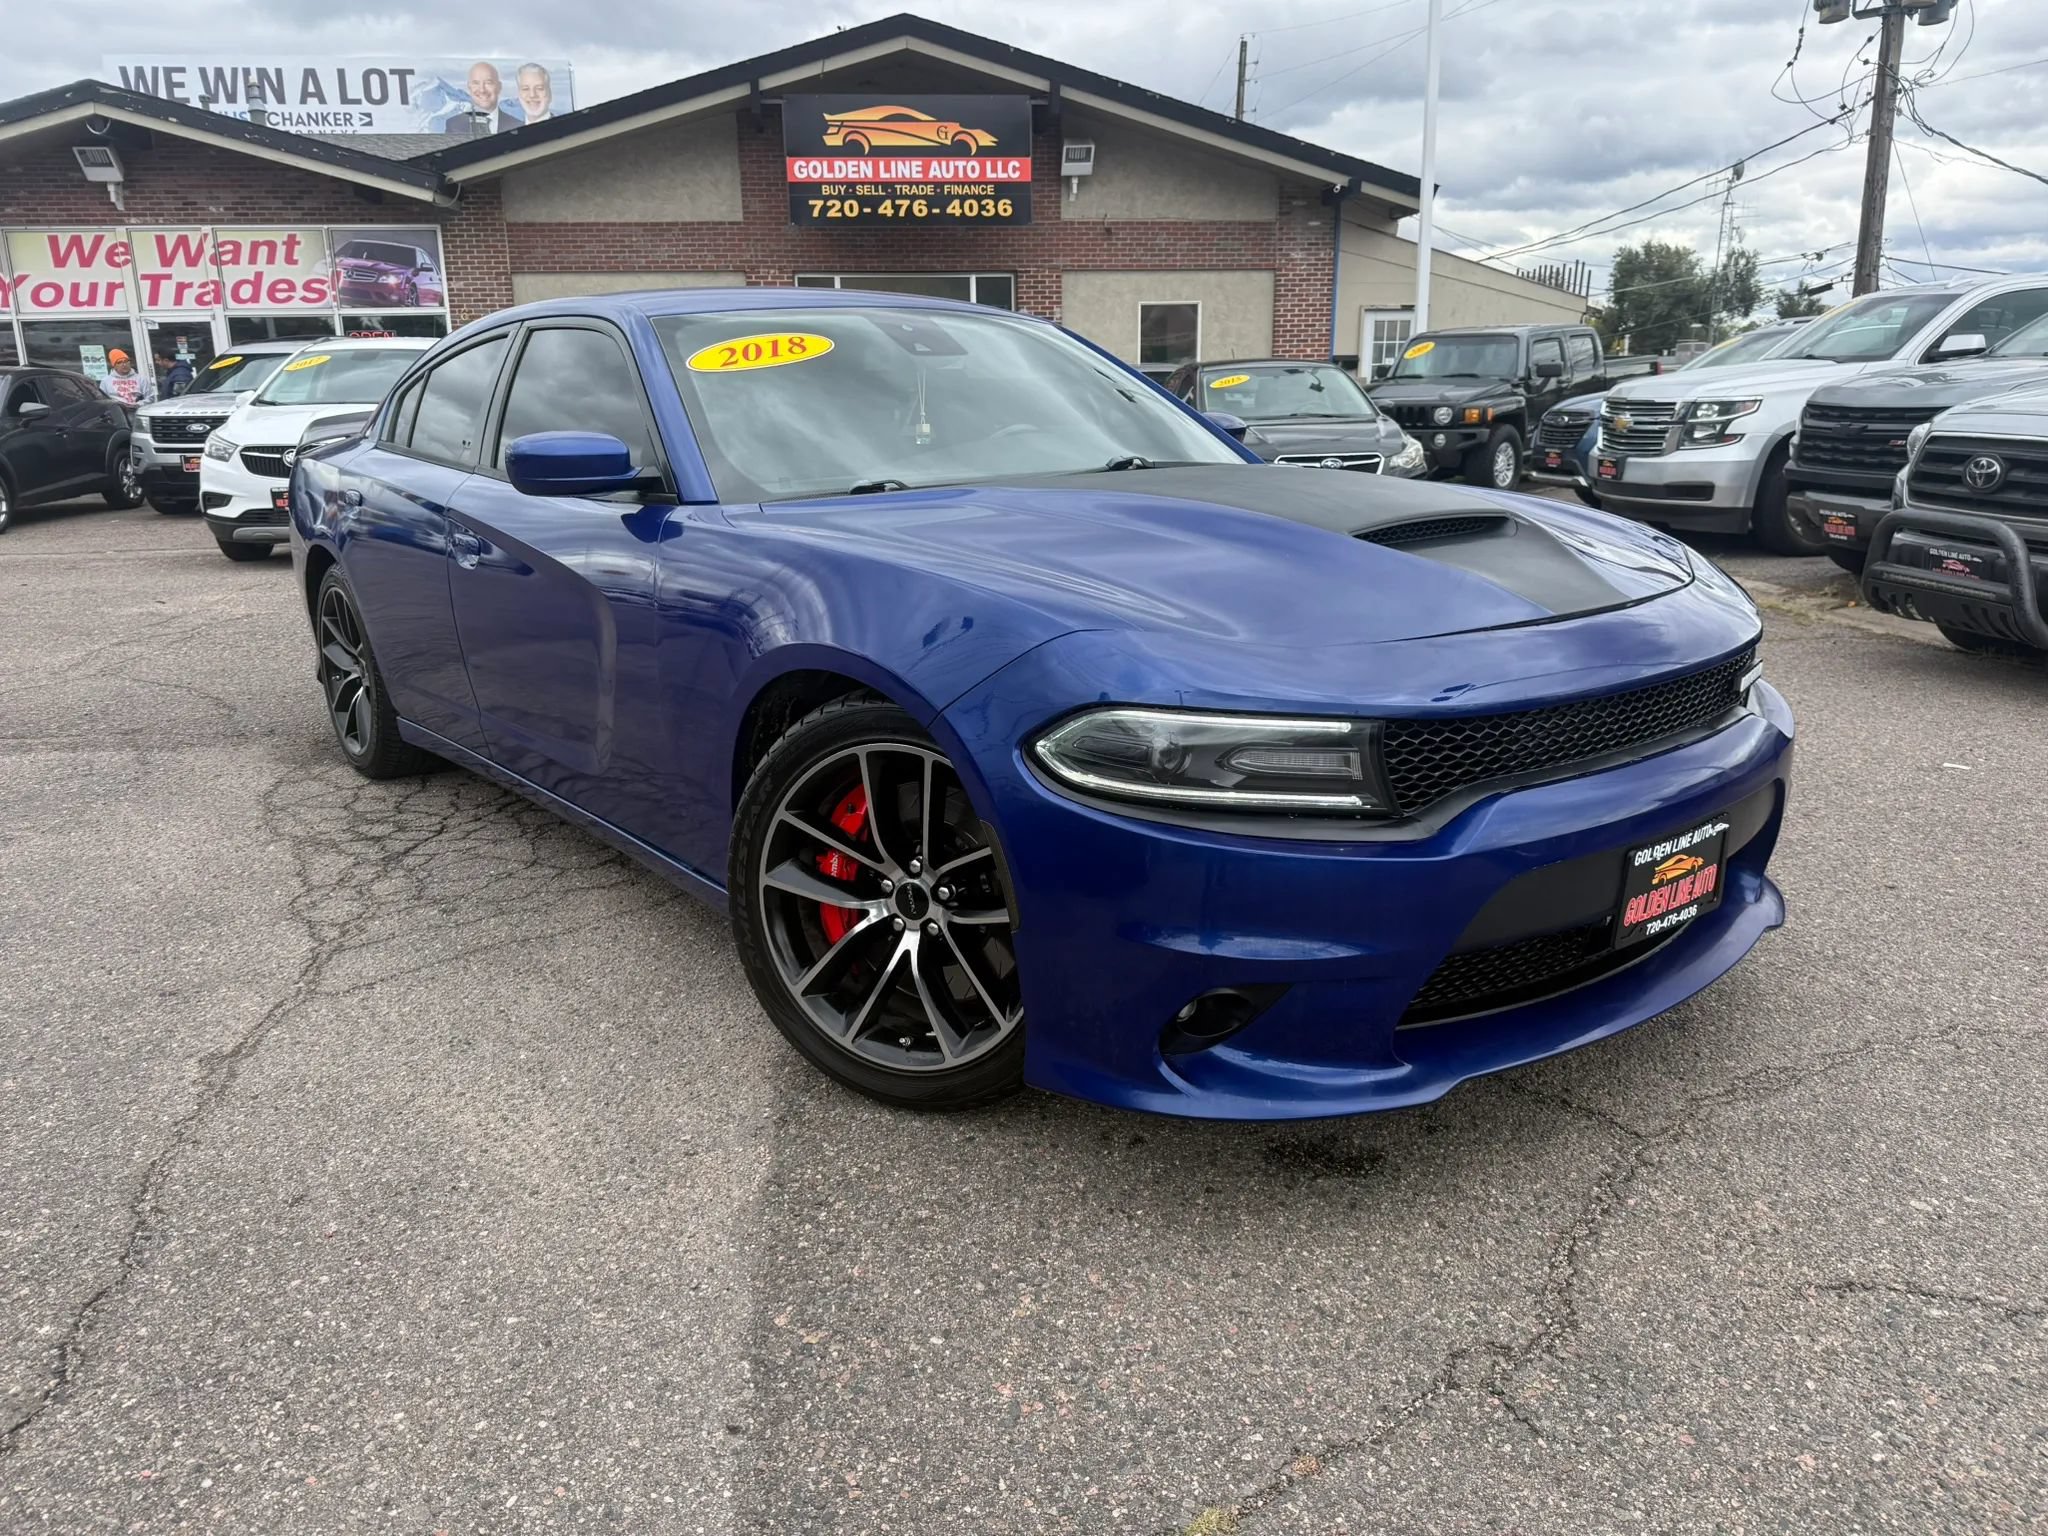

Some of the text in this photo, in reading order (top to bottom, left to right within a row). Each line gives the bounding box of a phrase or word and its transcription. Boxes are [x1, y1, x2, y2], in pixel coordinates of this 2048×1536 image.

[119, 66, 415, 106] WE WIN A LOT
[267, 112, 353, 127] CHANKER
[794, 161, 1020, 179] GOLDEN LINE AUTO LLC
[822, 185, 995, 195] BUY SELL TRADE FINANCE
[47, 233, 302, 268] We Want
[0, 270, 343, 308] Your Trades!
[718, 336, 807, 366] 2018
[1635, 824, 1712, 866] GOLDEN LINE AUTO
[1624, 864, 1717, 926] GOLDEN LINE AUTO
[1646, 905, 1697, 935] 720-476-4036
